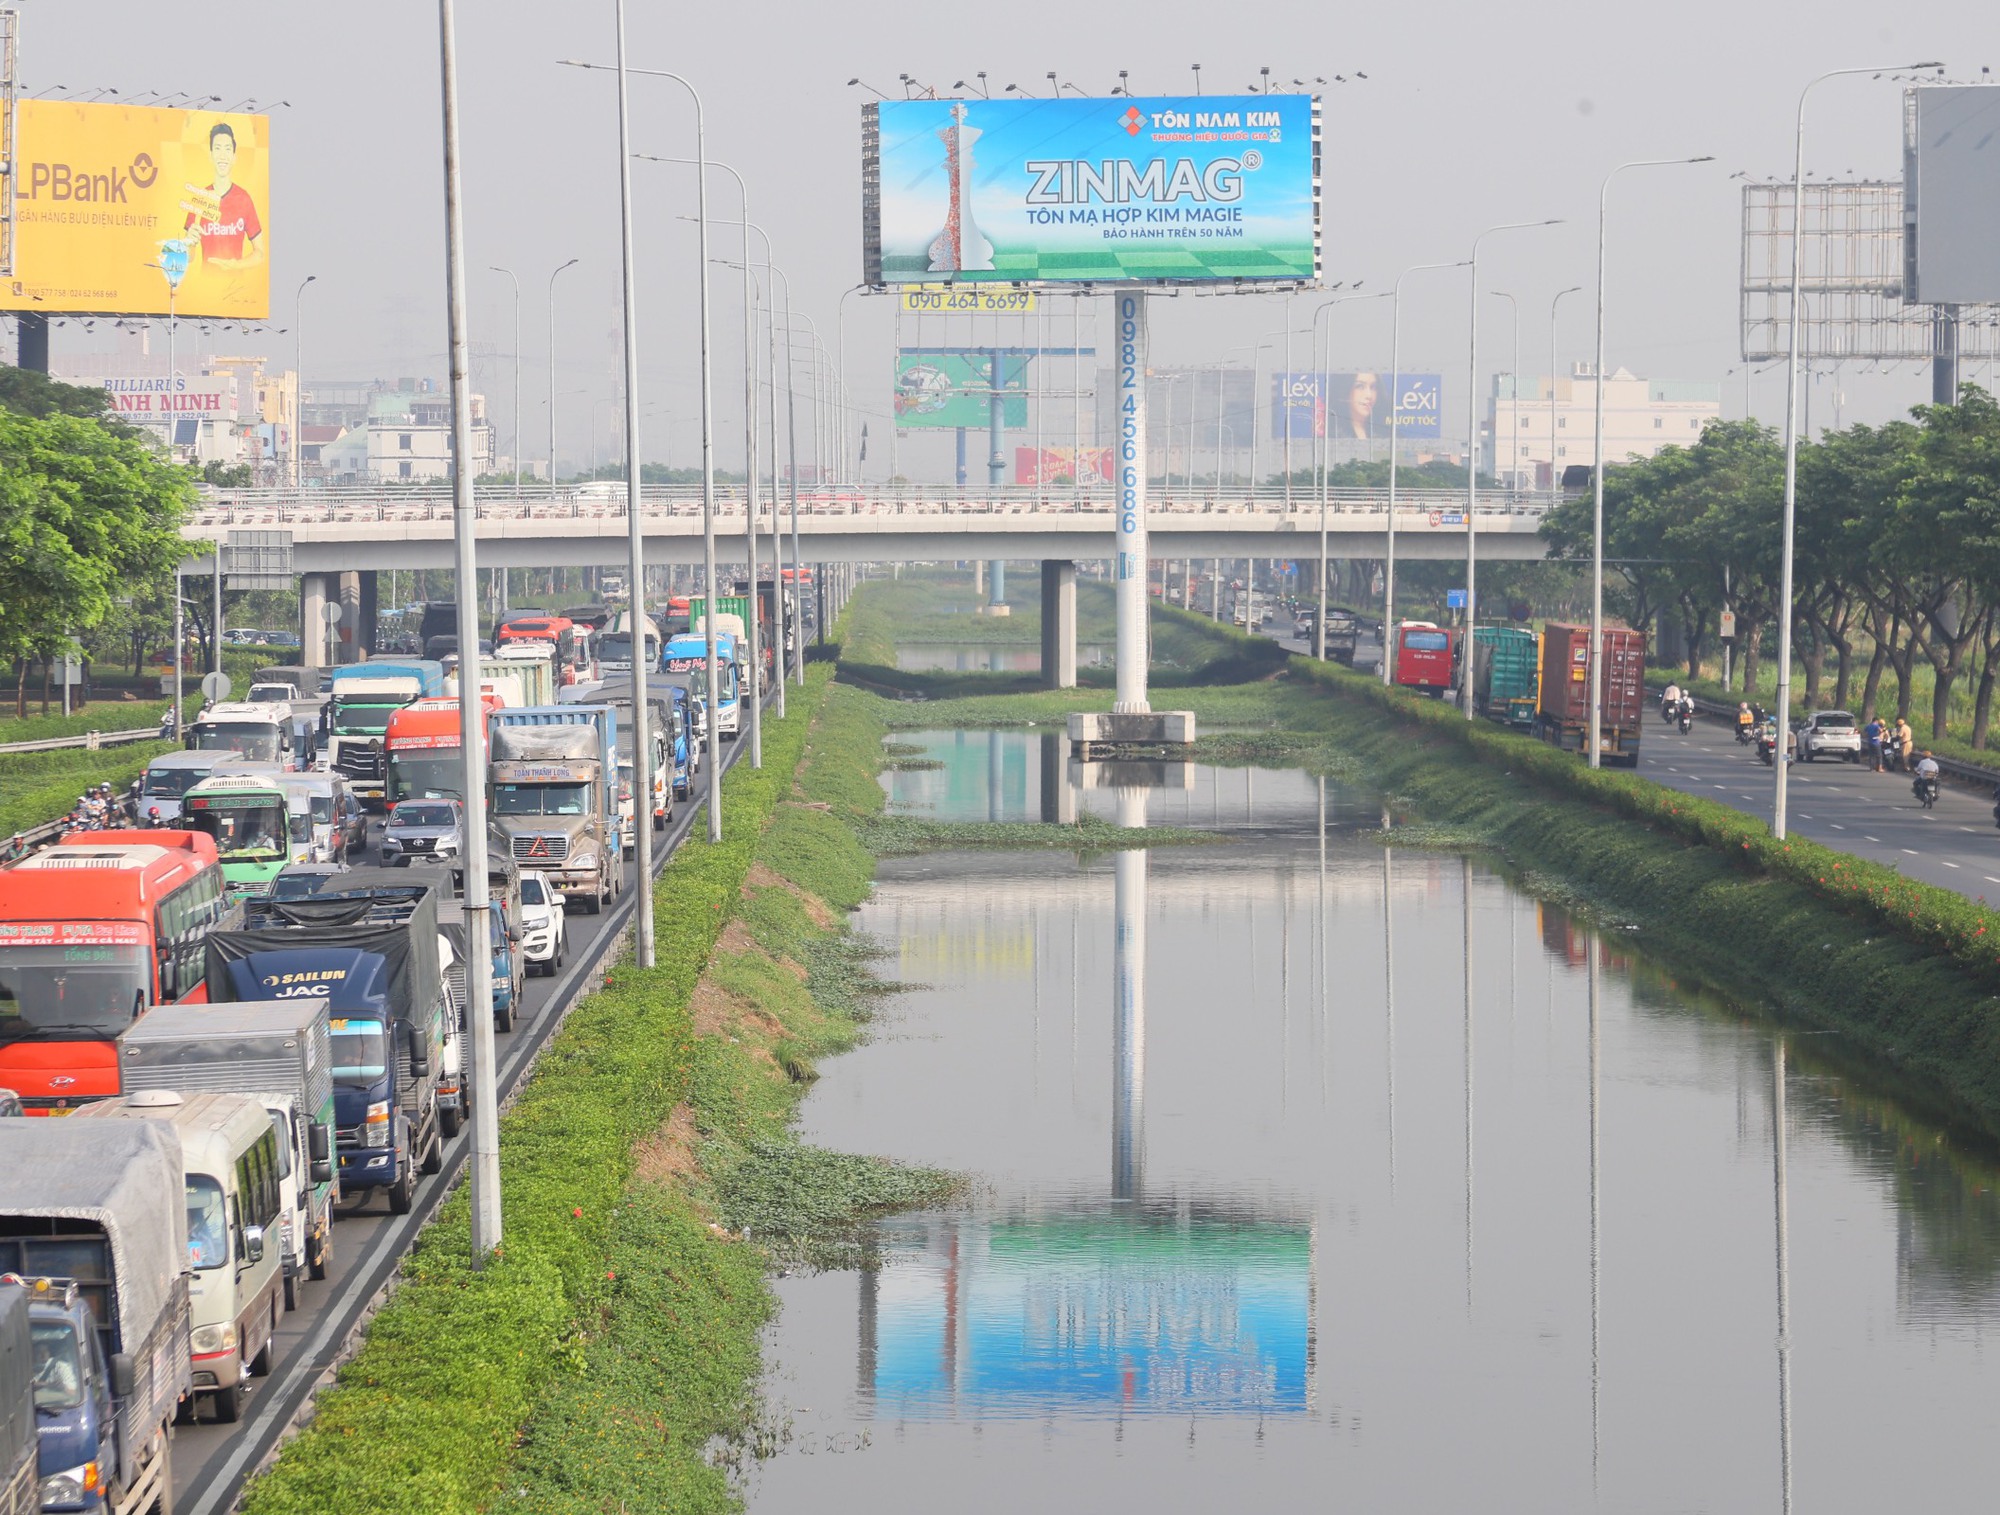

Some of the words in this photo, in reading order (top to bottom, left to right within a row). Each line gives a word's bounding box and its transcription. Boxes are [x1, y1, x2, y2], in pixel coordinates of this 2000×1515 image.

[1151, 110, 1190, 128] TÔN
[1195, 112, 1240, 128] NAM
[1246, 111, 1281, 127] KIM
[1195, 131, 1218, 142] HIỆU
[1221, 130, 1248, 141] QUỐC
[1252, 132, 1268, 140] GIA
[15, 162, 128, 203] LPBank
[1026, 158, 1242, 204] ZINMAG
[138, 213, 158, 230] VIỆT
[1026, 207, 1064, 224] TÔN
[1070, 209, 1098, 226] MẠ
[1103, 206, 1142, 226] HỢP
[1147, 208, 1180, 223] KIM
[1186, 207, 1242, 222] MAGIE
[203, 222, 237, 236] LPBank
[1130, 227, 1164, 238] HÀNH
[1168, 226, 1196, 238] TRÊN
[1200, 228, 1213, 238] 50
[1216, 226, 1243, 237] NĂM
[909, 293, 941, 309] 090
[947, 294, 979, 309] 464
[985, 293, 1029, 309] 6699
[160, 393, 221, 411] MINH
[1417, 415, 1438, 426] TÓC
[553, 769, 570, 777] LONG
[281, 970, 346, 984] SAILUN
[275, 984, 331, 998] JAC
